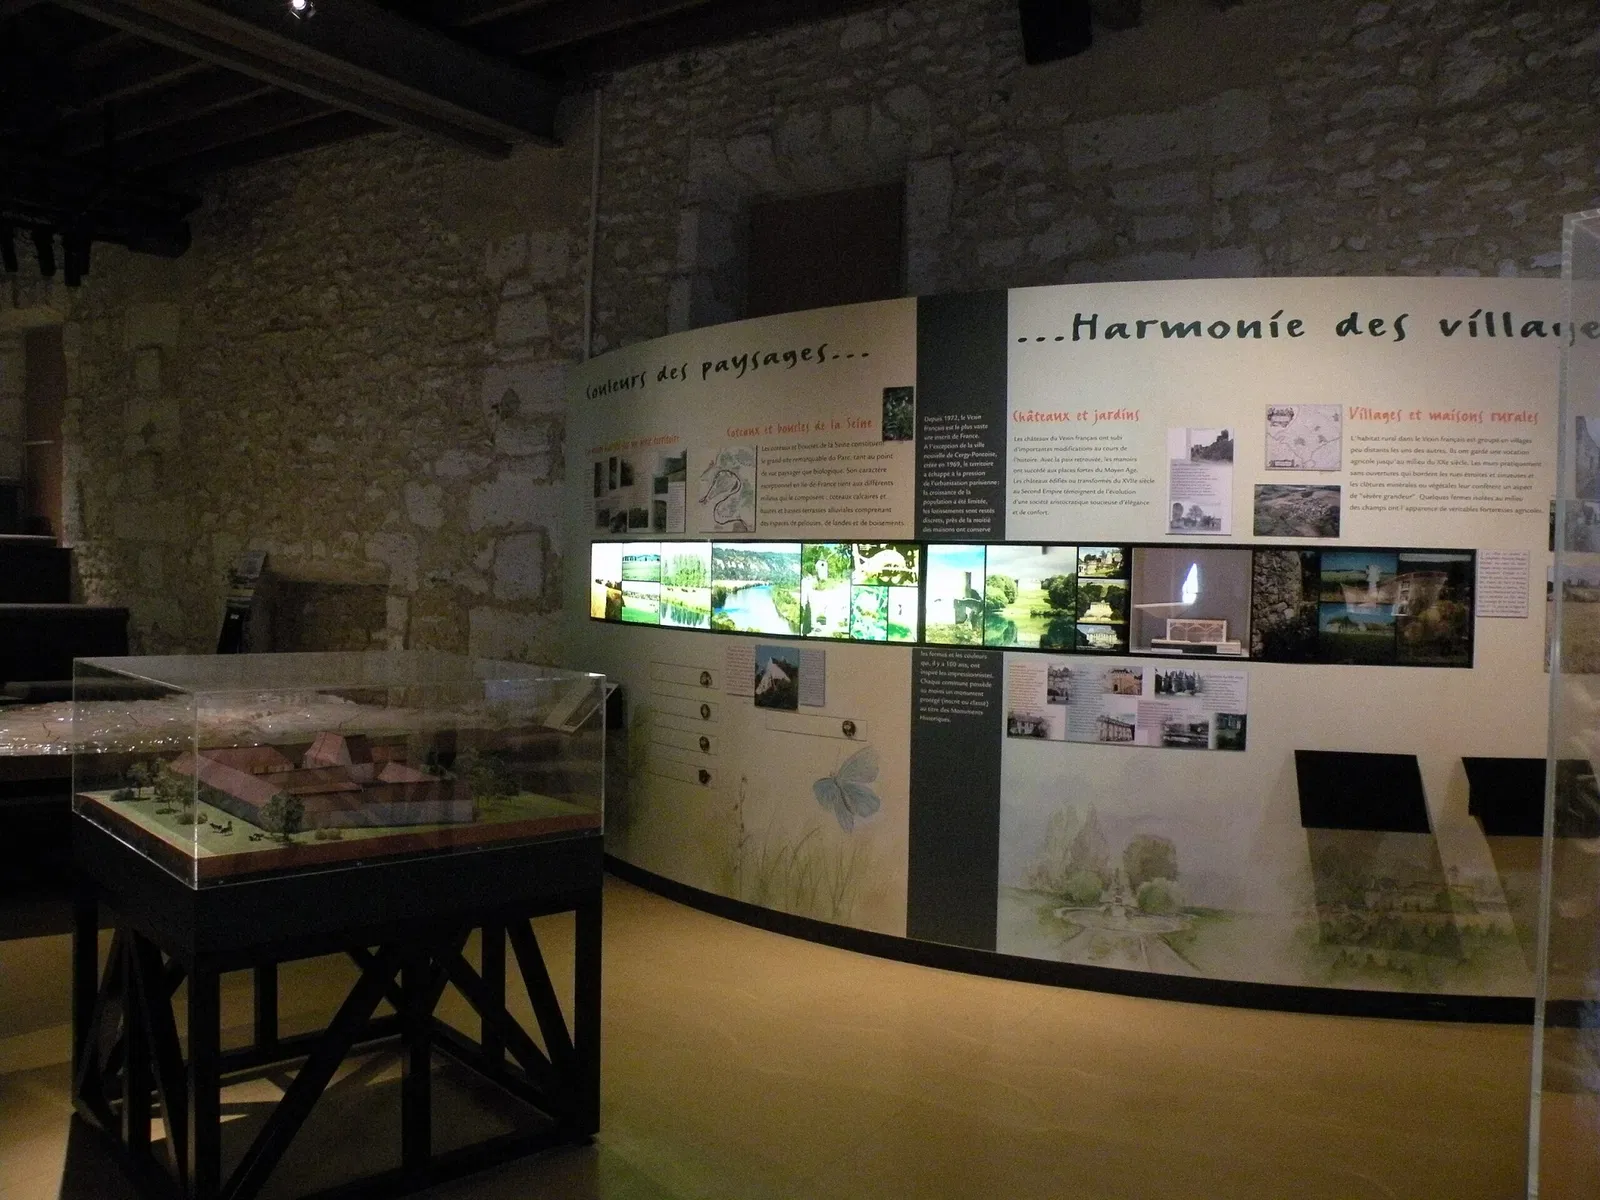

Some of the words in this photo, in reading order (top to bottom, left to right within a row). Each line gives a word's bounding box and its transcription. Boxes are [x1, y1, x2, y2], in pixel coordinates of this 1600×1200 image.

[1335, 311, 1409, 342] des
[586, 371, 646, 400] Couleurs
[657, 363, 688, 382] des
[1013, 410, 1070, 422] Châteaux
[1077, 410, 1088, 421] et
[1092, 408, 1140, 426] jardins
[1349, 406, 1401, 424] Villages
[1409, 409, 1422, 421] et
[1429, 408, 1483, 424] maisons
[1490, 409, 1539, 425] rurales
[778, 421, 809, 434] boucles
[815, 420, 825, 431] de
[831, 419, 840, 430] la
[847, 417, 873, 429] Seine
